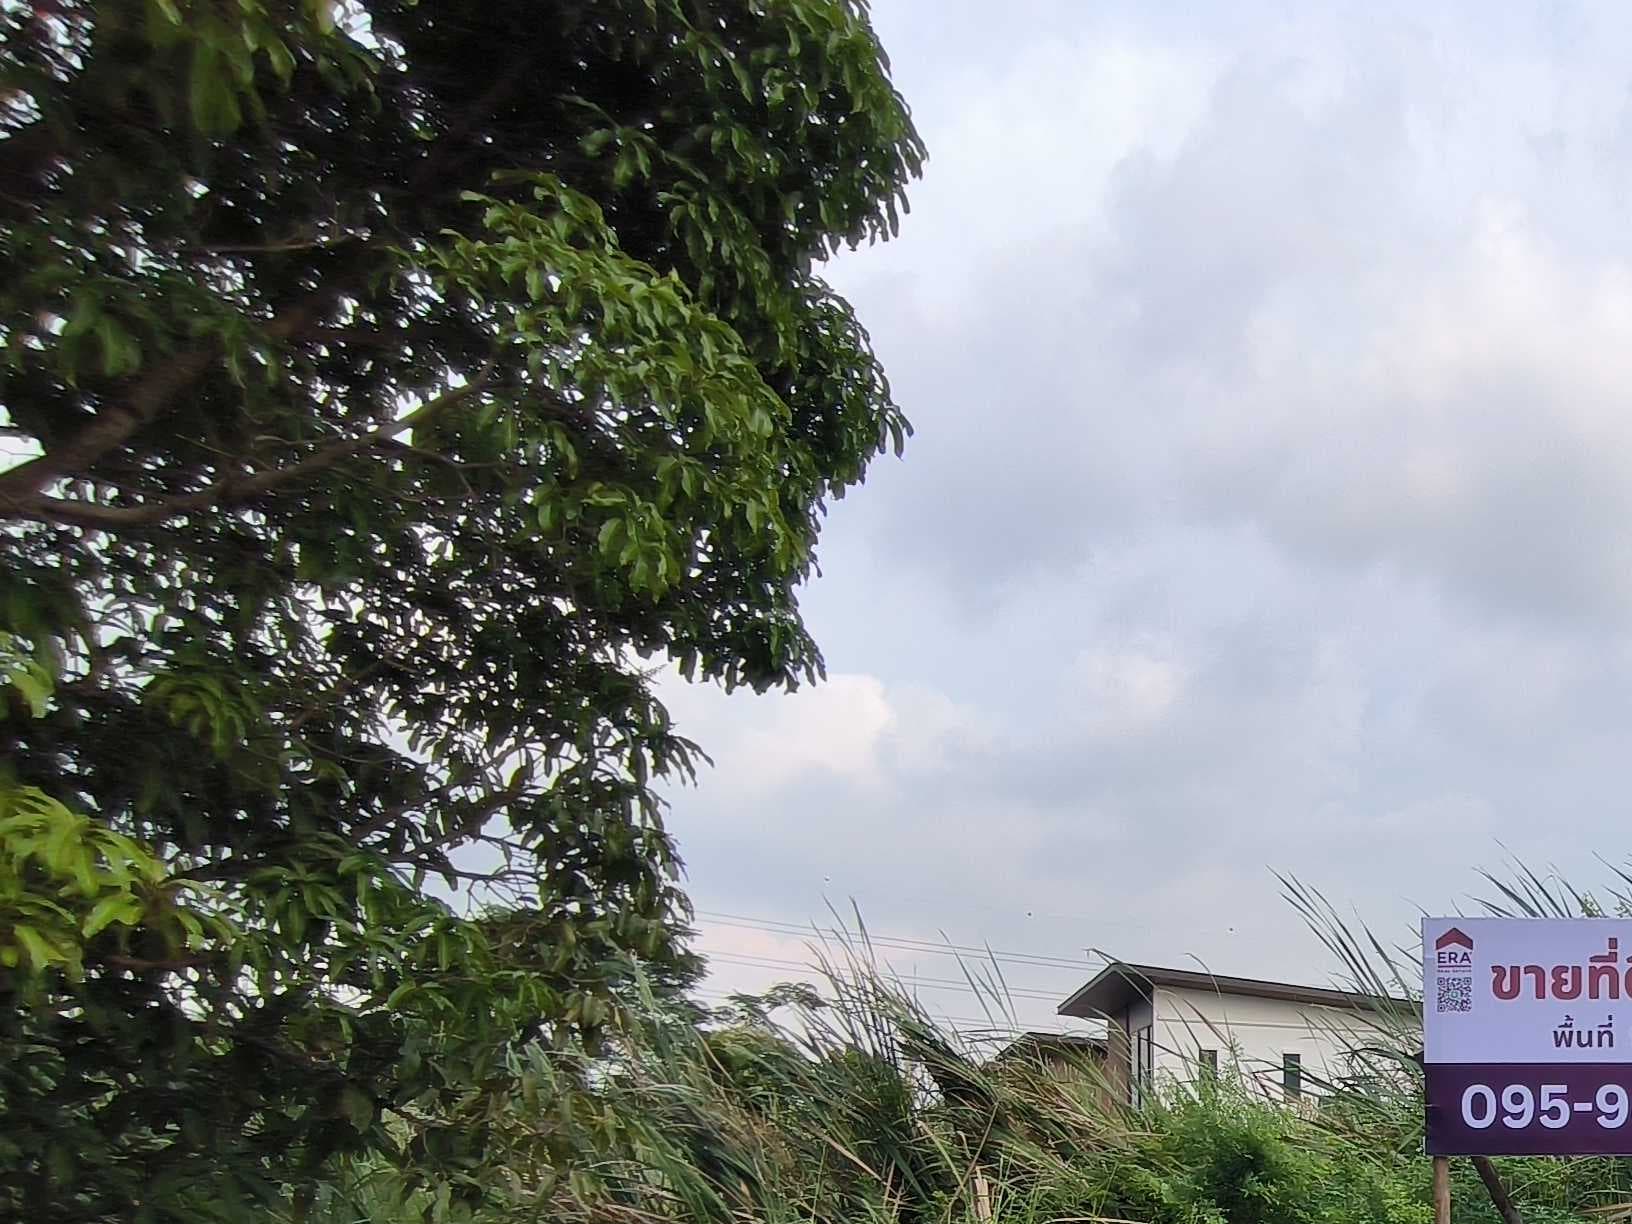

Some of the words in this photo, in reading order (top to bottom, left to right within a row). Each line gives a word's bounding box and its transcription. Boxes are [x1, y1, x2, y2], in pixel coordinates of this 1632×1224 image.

[1437, 951, 1472, 964] ERA
[1553, 1015, 1614, 1048] พื้นที่
